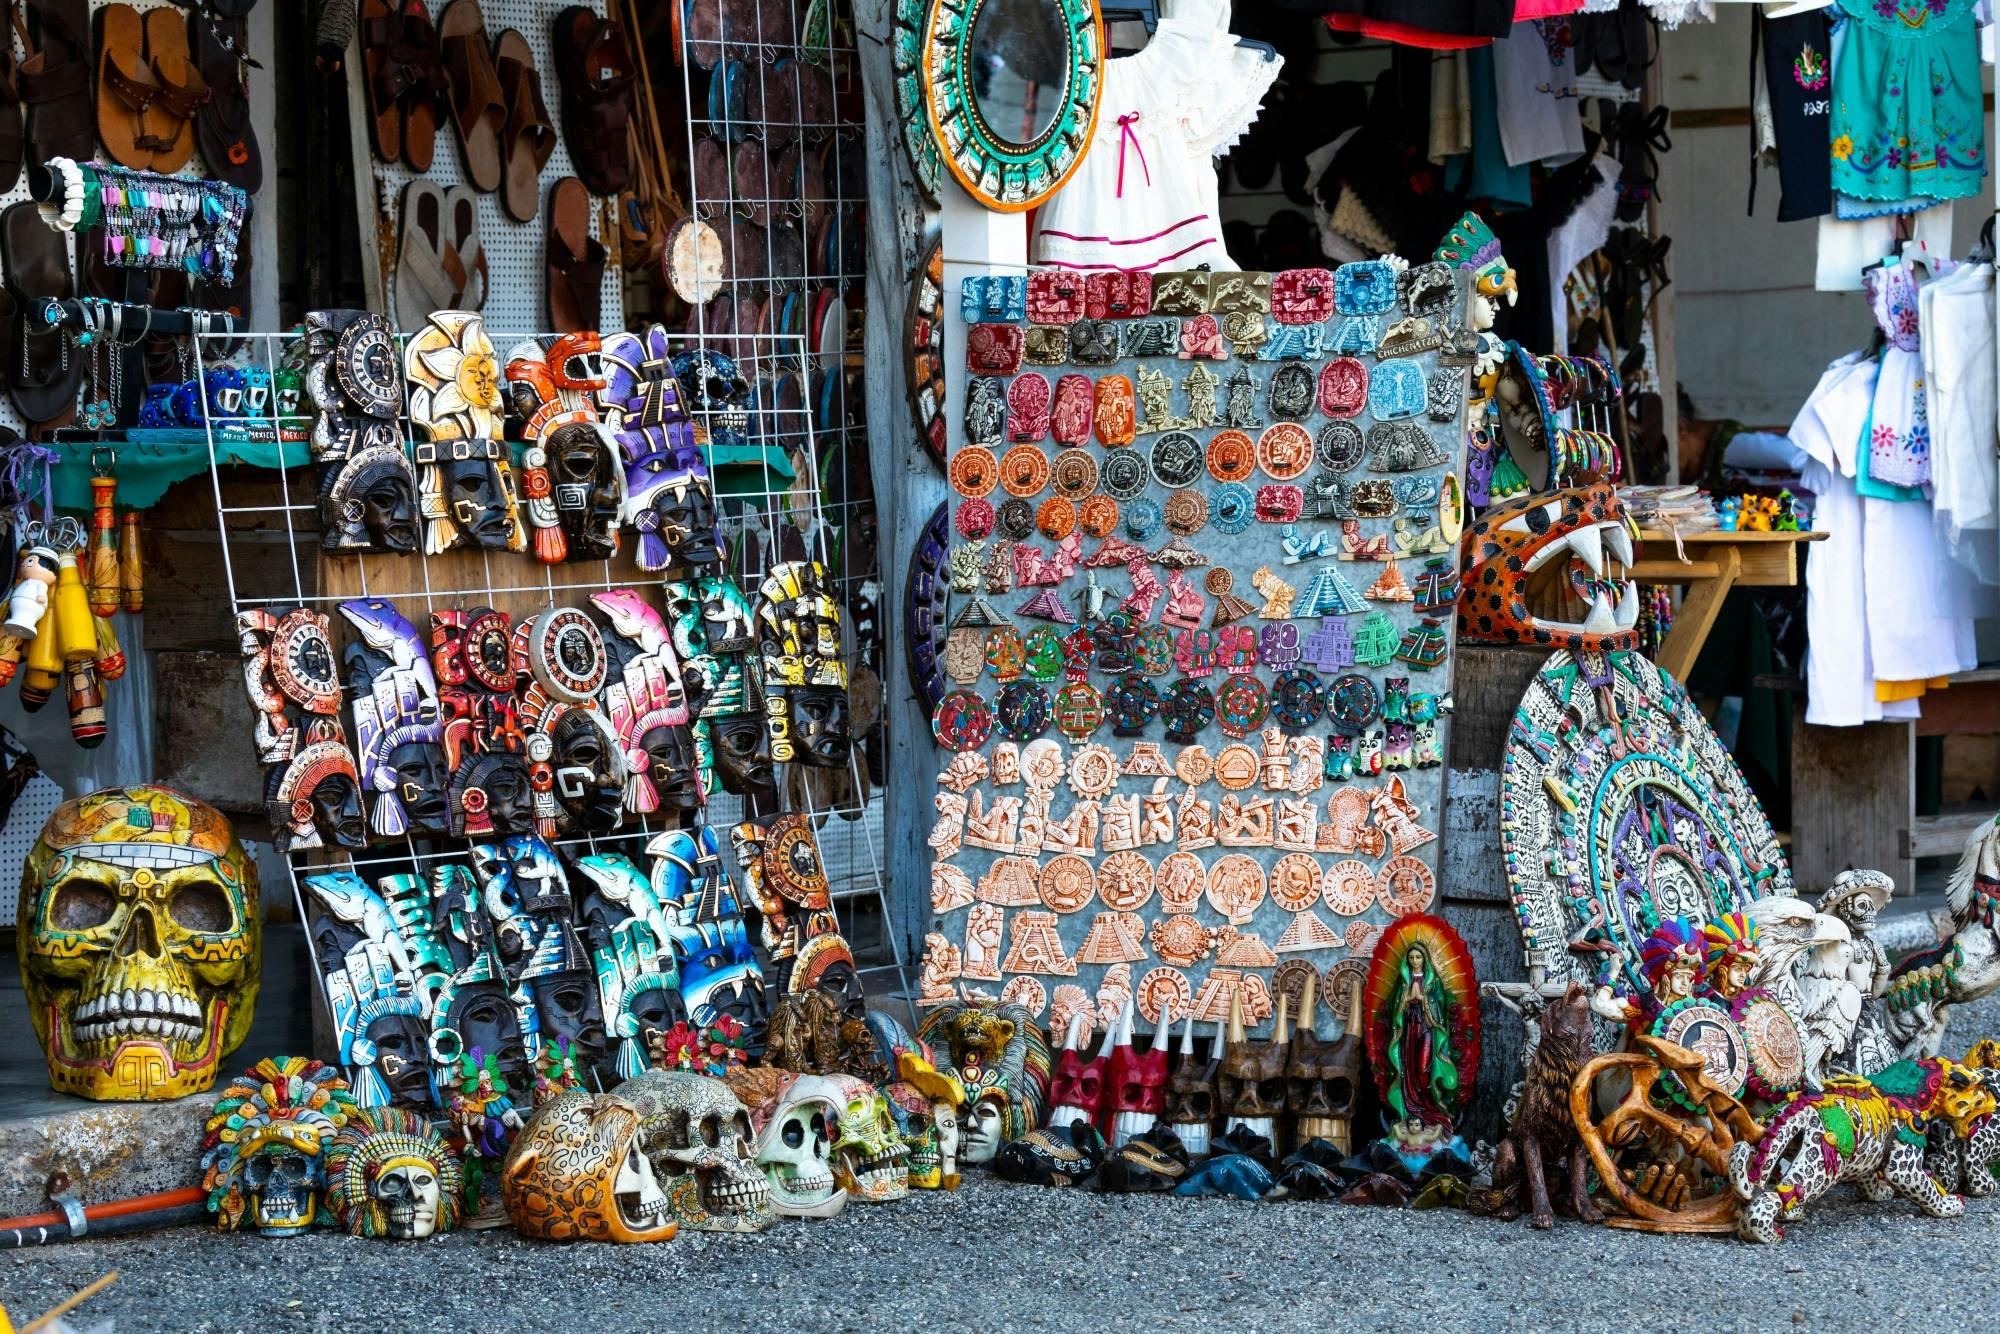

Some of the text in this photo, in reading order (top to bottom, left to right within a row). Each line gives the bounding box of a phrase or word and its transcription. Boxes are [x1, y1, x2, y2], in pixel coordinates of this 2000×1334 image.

[1377, 343, 1416, 359] CHICHEN
[283, 431, 309, 440] MEXICO
[1227, 665, 1251, 674] ZACI
[1271, 662, 1295, 673] ZACI
